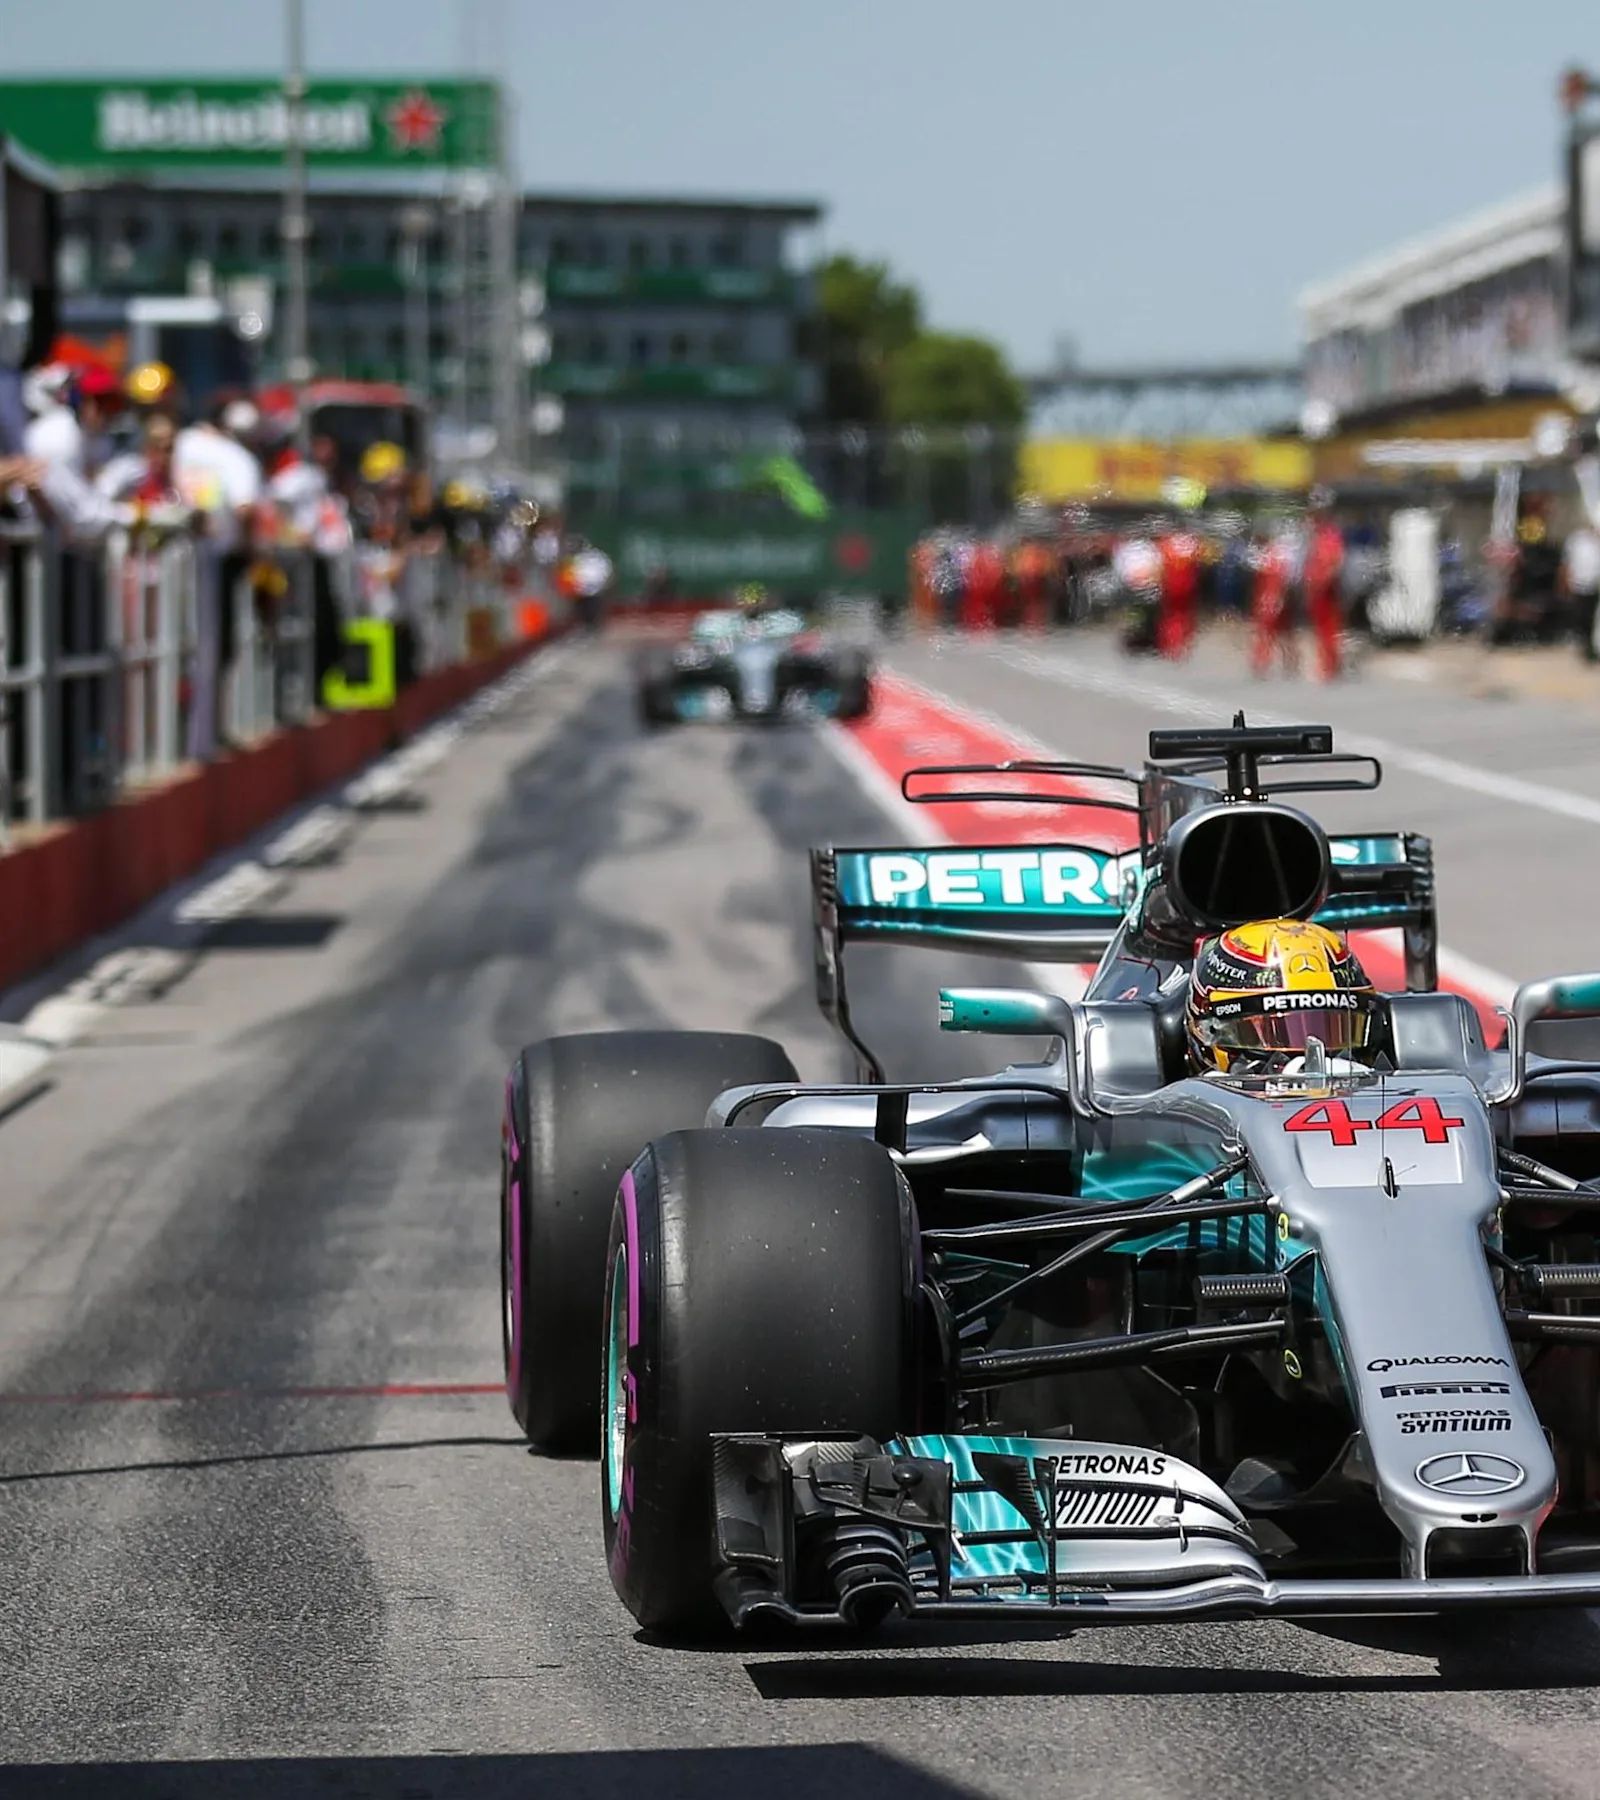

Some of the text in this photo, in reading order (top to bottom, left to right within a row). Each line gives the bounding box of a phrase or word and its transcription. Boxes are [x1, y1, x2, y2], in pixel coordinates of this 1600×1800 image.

[1216, 1003, 1242, 1016] EPSON
[1263, 993, 1359, 1011] PETRONAS
[1283, 1097, 1465, 1146] 44
[1380, 1381, 1511, 1399] PIRELLI
[1396, 1410, 1511, 1419] PETRONAS
[1401, 1418, 1512, 1434] SYNTIUM
